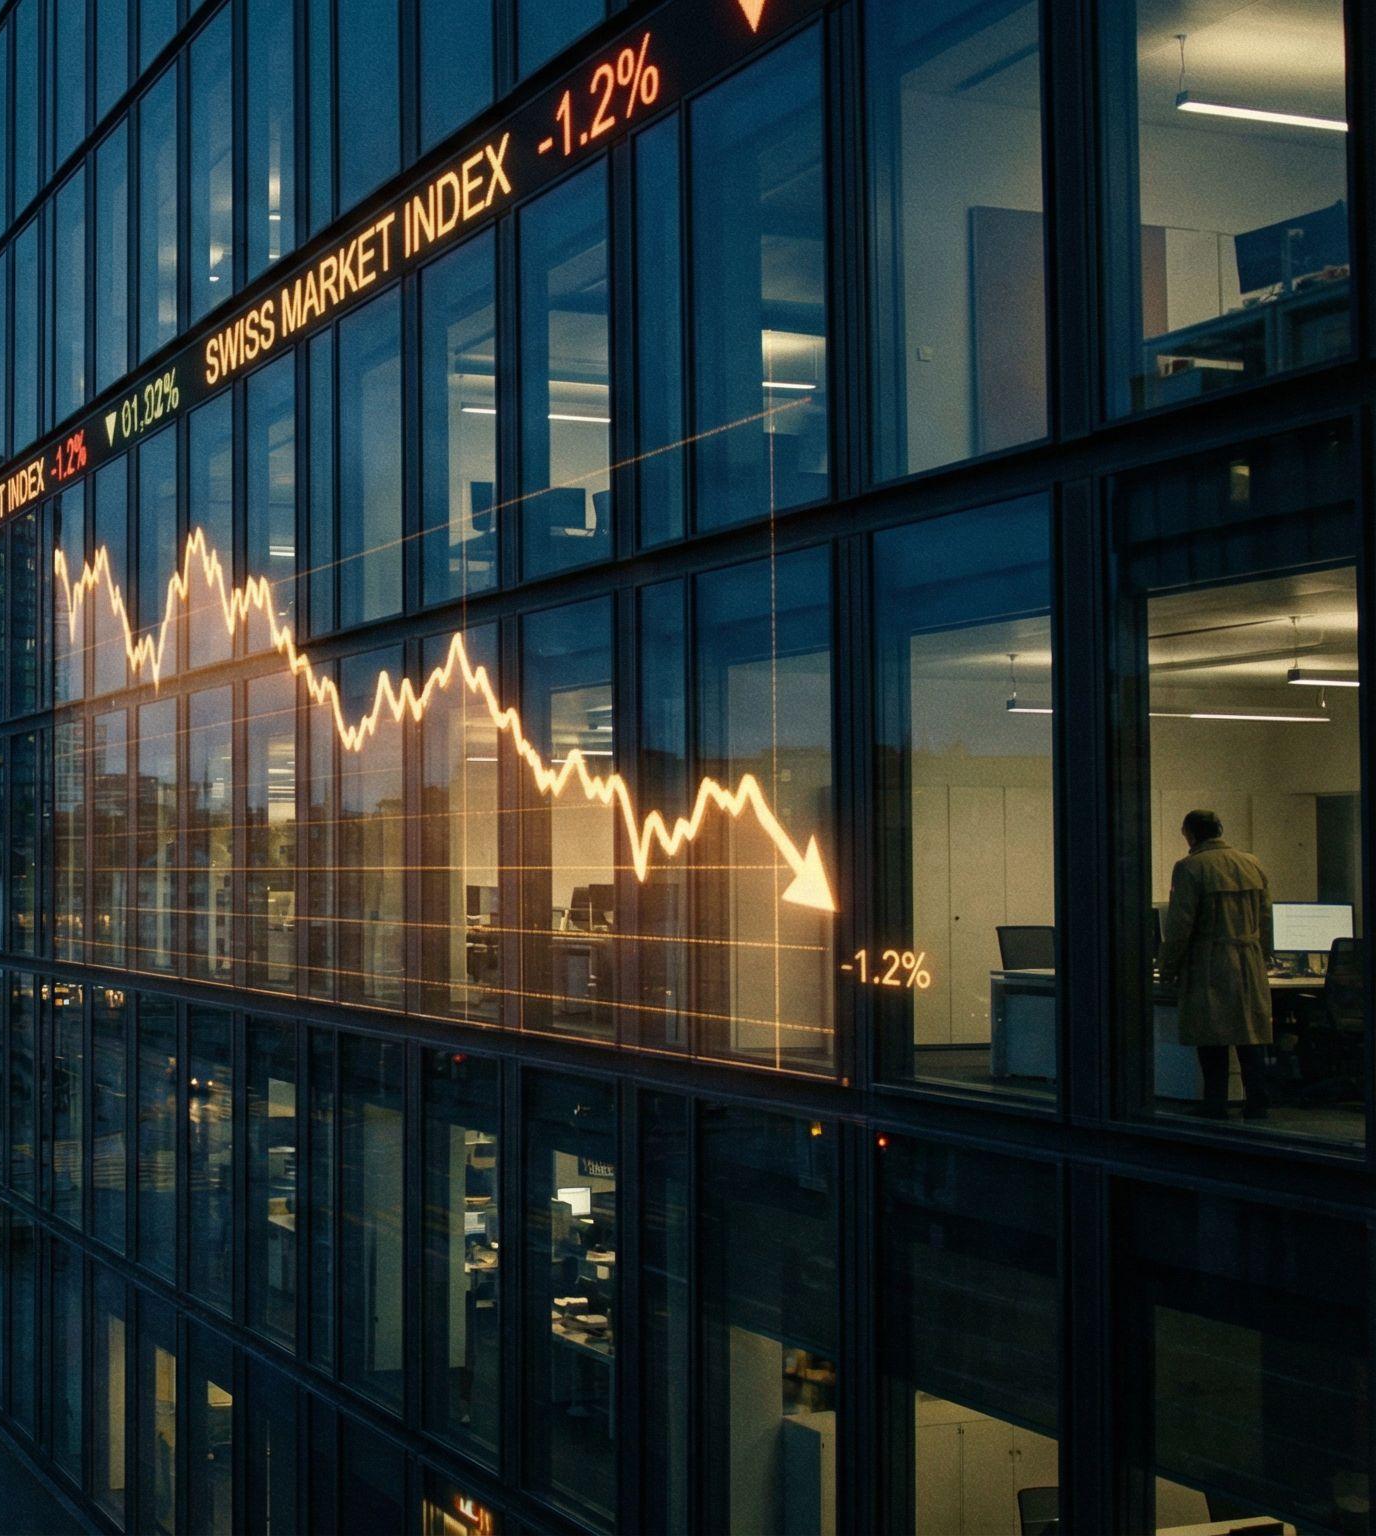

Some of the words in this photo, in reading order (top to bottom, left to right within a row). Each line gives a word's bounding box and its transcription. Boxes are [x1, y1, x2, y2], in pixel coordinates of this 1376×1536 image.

[205, 300, 275, 385] SWISS
[281, 212, 395, 338] MARKET
[404, 132, 512, 258] INDEX
[538, 32, 659, 156] -1.2%
[7, 456, 45, 512] INDEX
[50, 429, 87, 481] -1.2%
[841, 949, 931, 989] -1.2%
